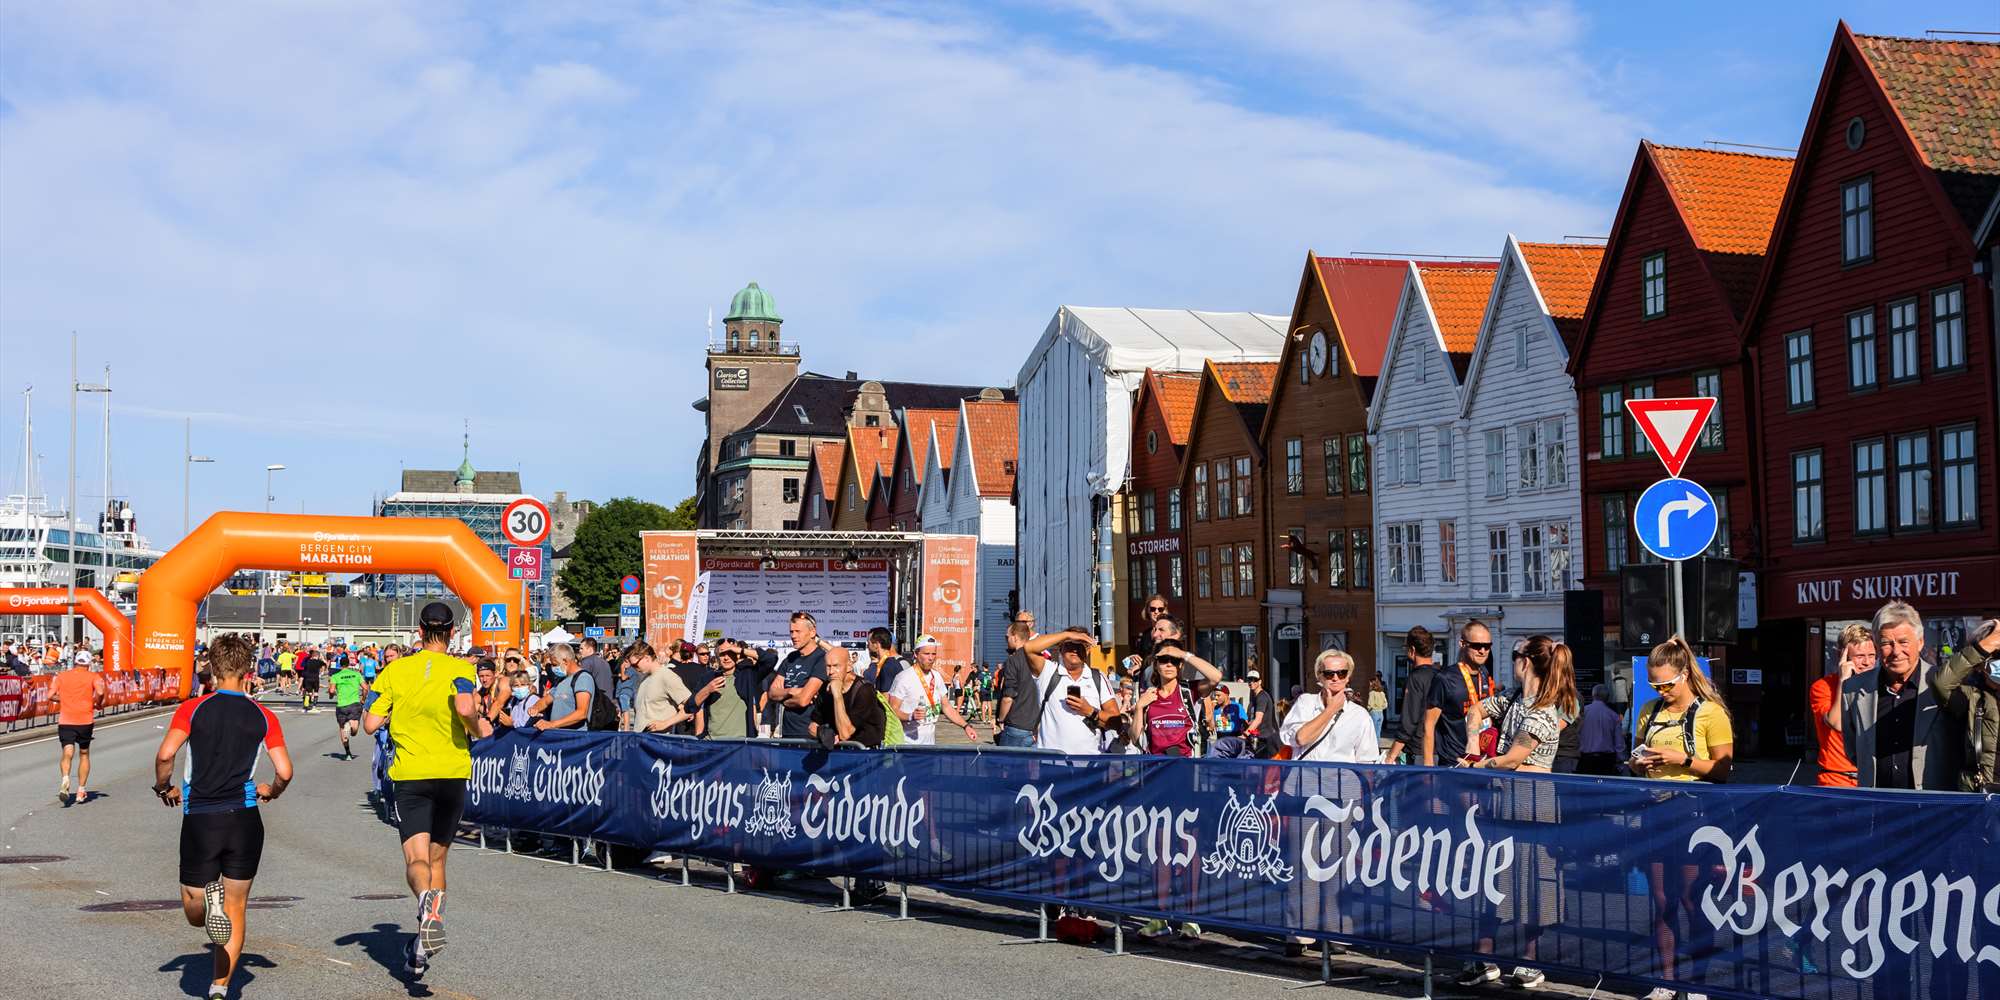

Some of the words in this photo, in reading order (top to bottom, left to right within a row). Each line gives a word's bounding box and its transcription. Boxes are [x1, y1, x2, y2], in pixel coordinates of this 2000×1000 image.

[511, 511, 543, 534] 30
[300, 543, 344, 553] BERGEN
[349, 545, 373, 553] CITY
[1138, 537, 1180, 555] STORHEIM
[300, 553, 372, 564] MARATHON
[716, 561, 755, 569] Fjordkraft
[781, 561, 819, 569] Fjordkraft
[859, 561, 882, 569] dkraft
[525, 569, 535, 577] 30
[1797, 579, 1842, 604] KNUT
[1852, 571, 1960, 600] SKURTVEIT
[22, 595, 68, 606] Fjordkraft
[144, 643, 185, 651] MARATHON
[111, 640, 120, 671] jordkraft
[533, 747, 604, 807] Tidende
[650, 758, 747, 840] Bergens
[800, 773, 925, 849] Tidende
[1015, 783, 1200, 882] Bergens
[1301, 794, 1515, 906] Tidende
